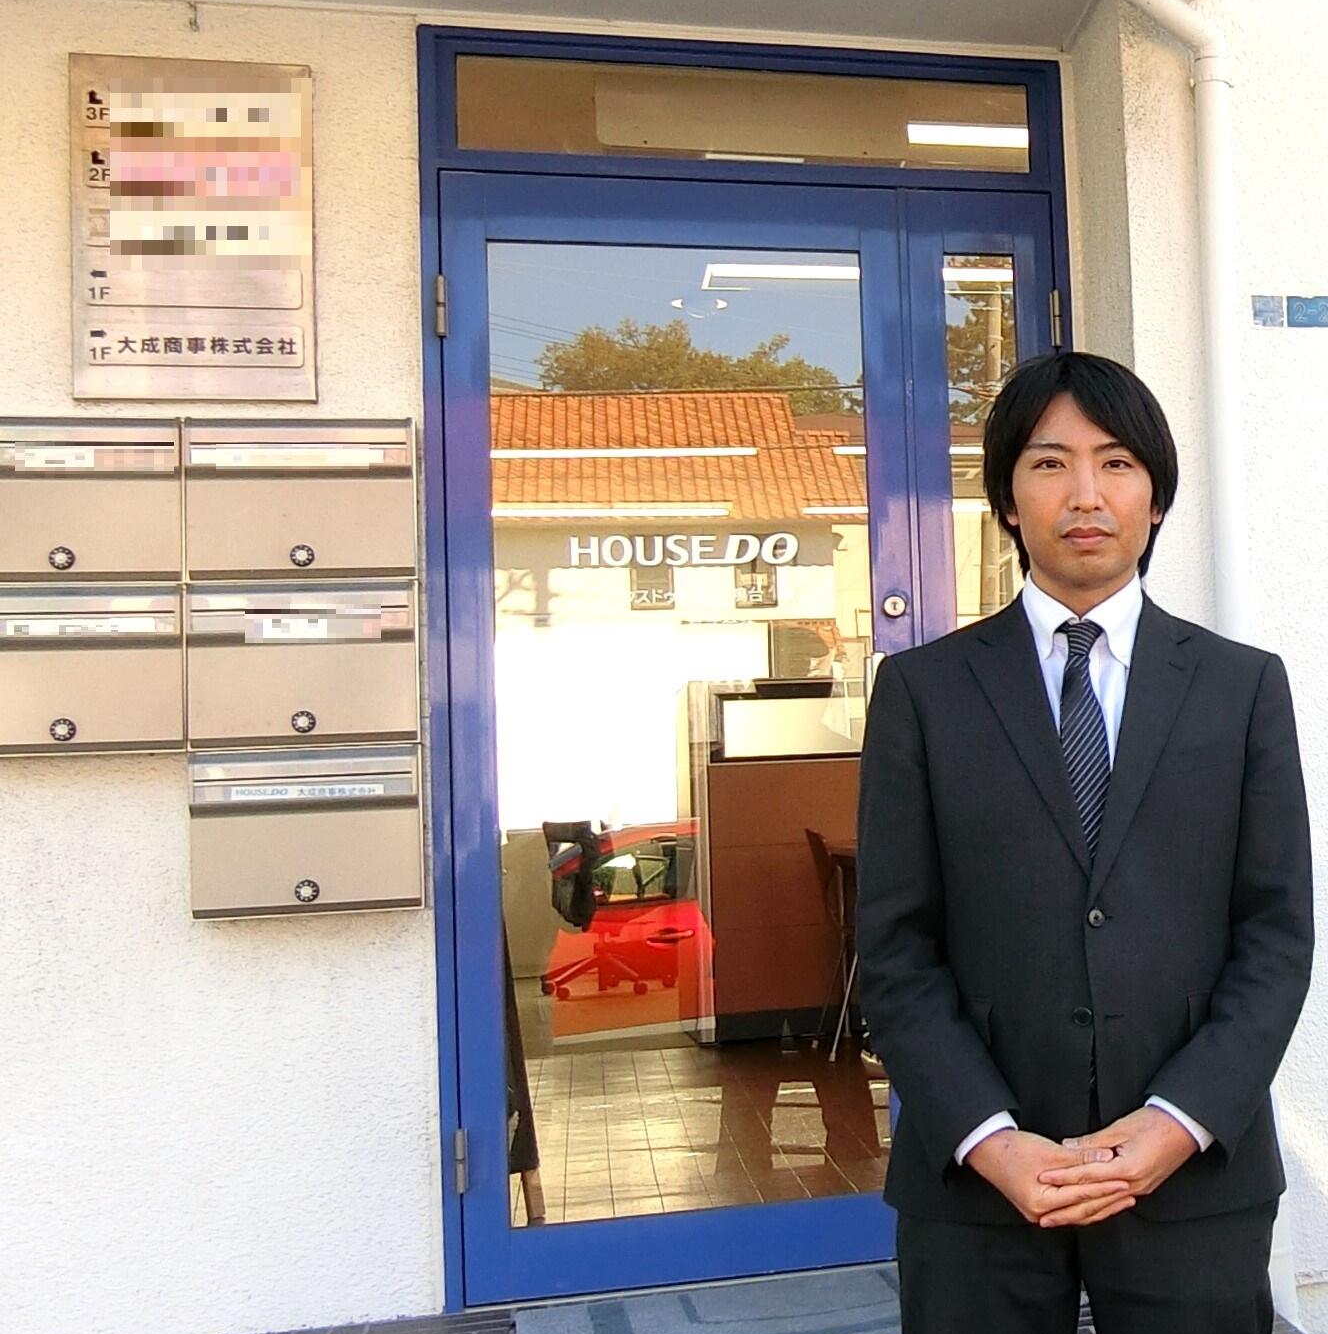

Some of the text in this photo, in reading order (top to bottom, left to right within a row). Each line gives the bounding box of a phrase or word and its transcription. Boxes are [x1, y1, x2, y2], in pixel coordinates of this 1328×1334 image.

[86, 107, 110, 121] 3F
[89, 168, 110, 182] 2F
[88, 287, 111, 300] 1F
[90, 336, 298, 360] 1F 大成商事株式会社
